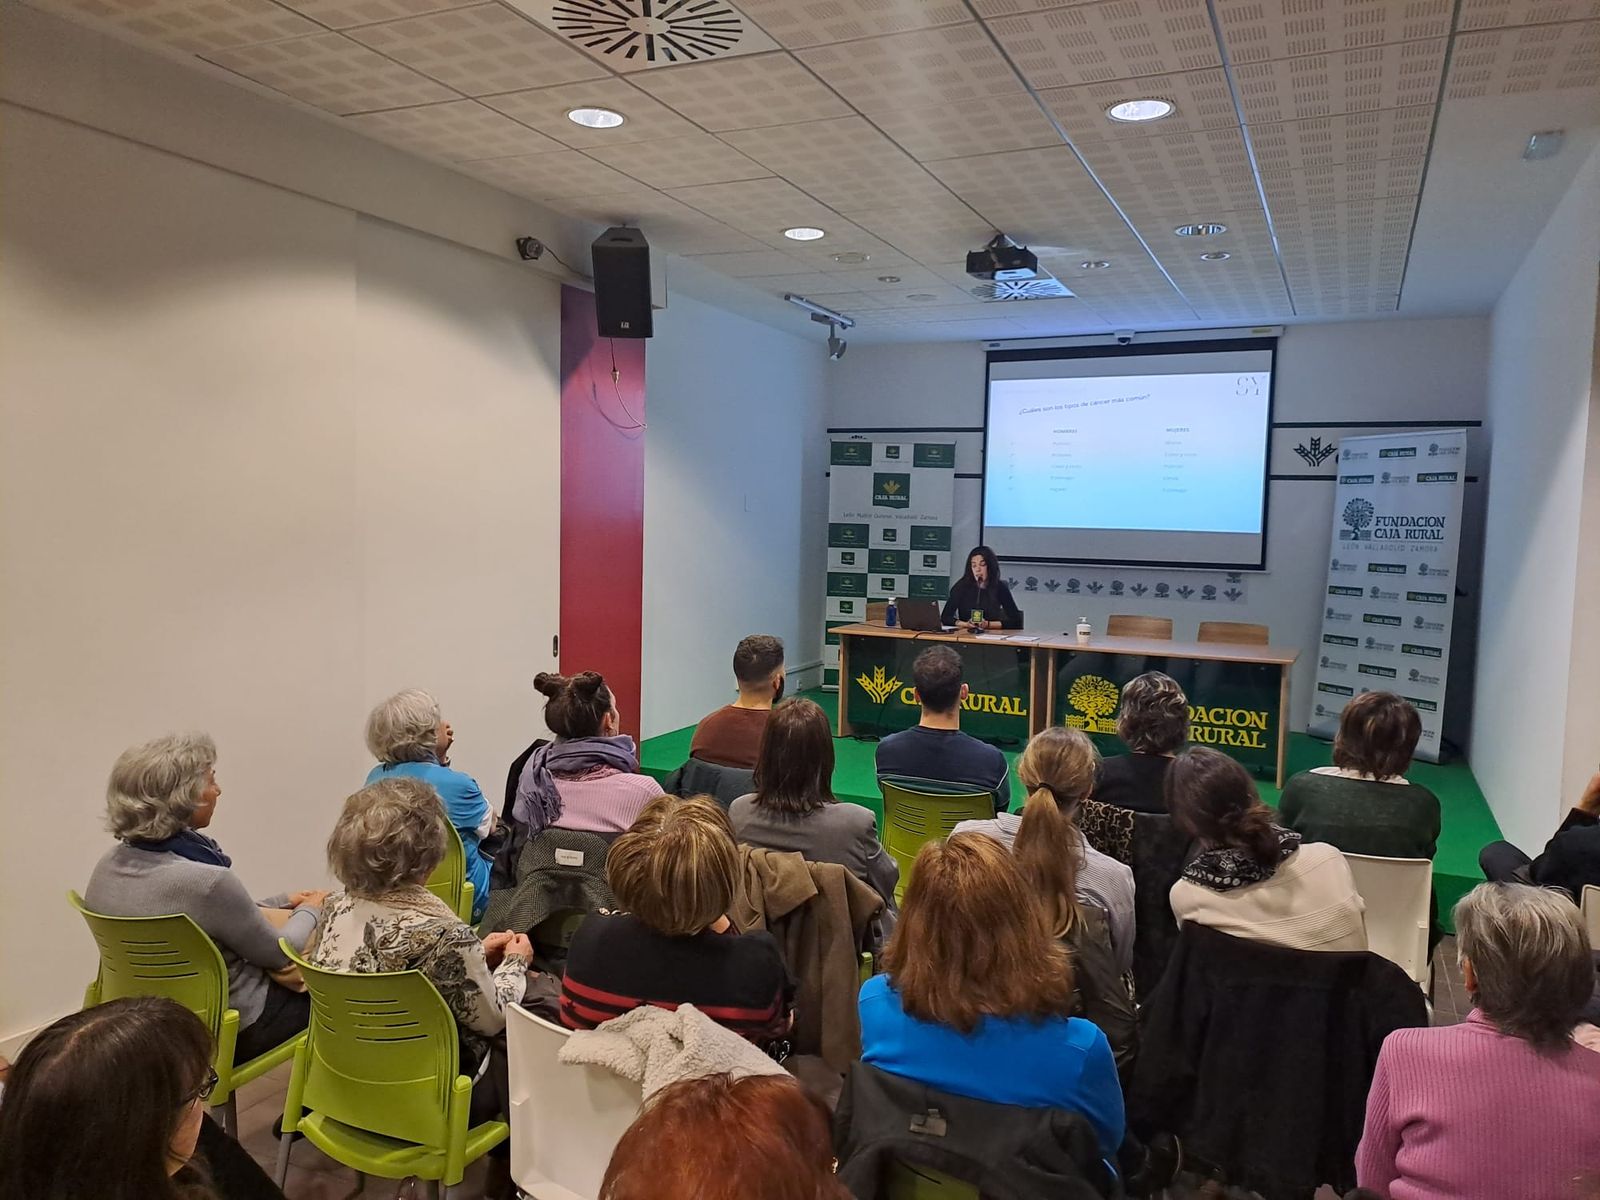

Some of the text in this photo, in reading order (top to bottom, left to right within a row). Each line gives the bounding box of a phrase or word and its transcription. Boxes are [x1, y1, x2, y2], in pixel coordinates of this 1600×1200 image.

[1375, 516, 1446, 528] FUNDACION
[1374, 528, 1444, 540] CAJA RURAL
[1187, 705, 1268, 730] DACION
[1188, 725, 1266, 748] RURAL
